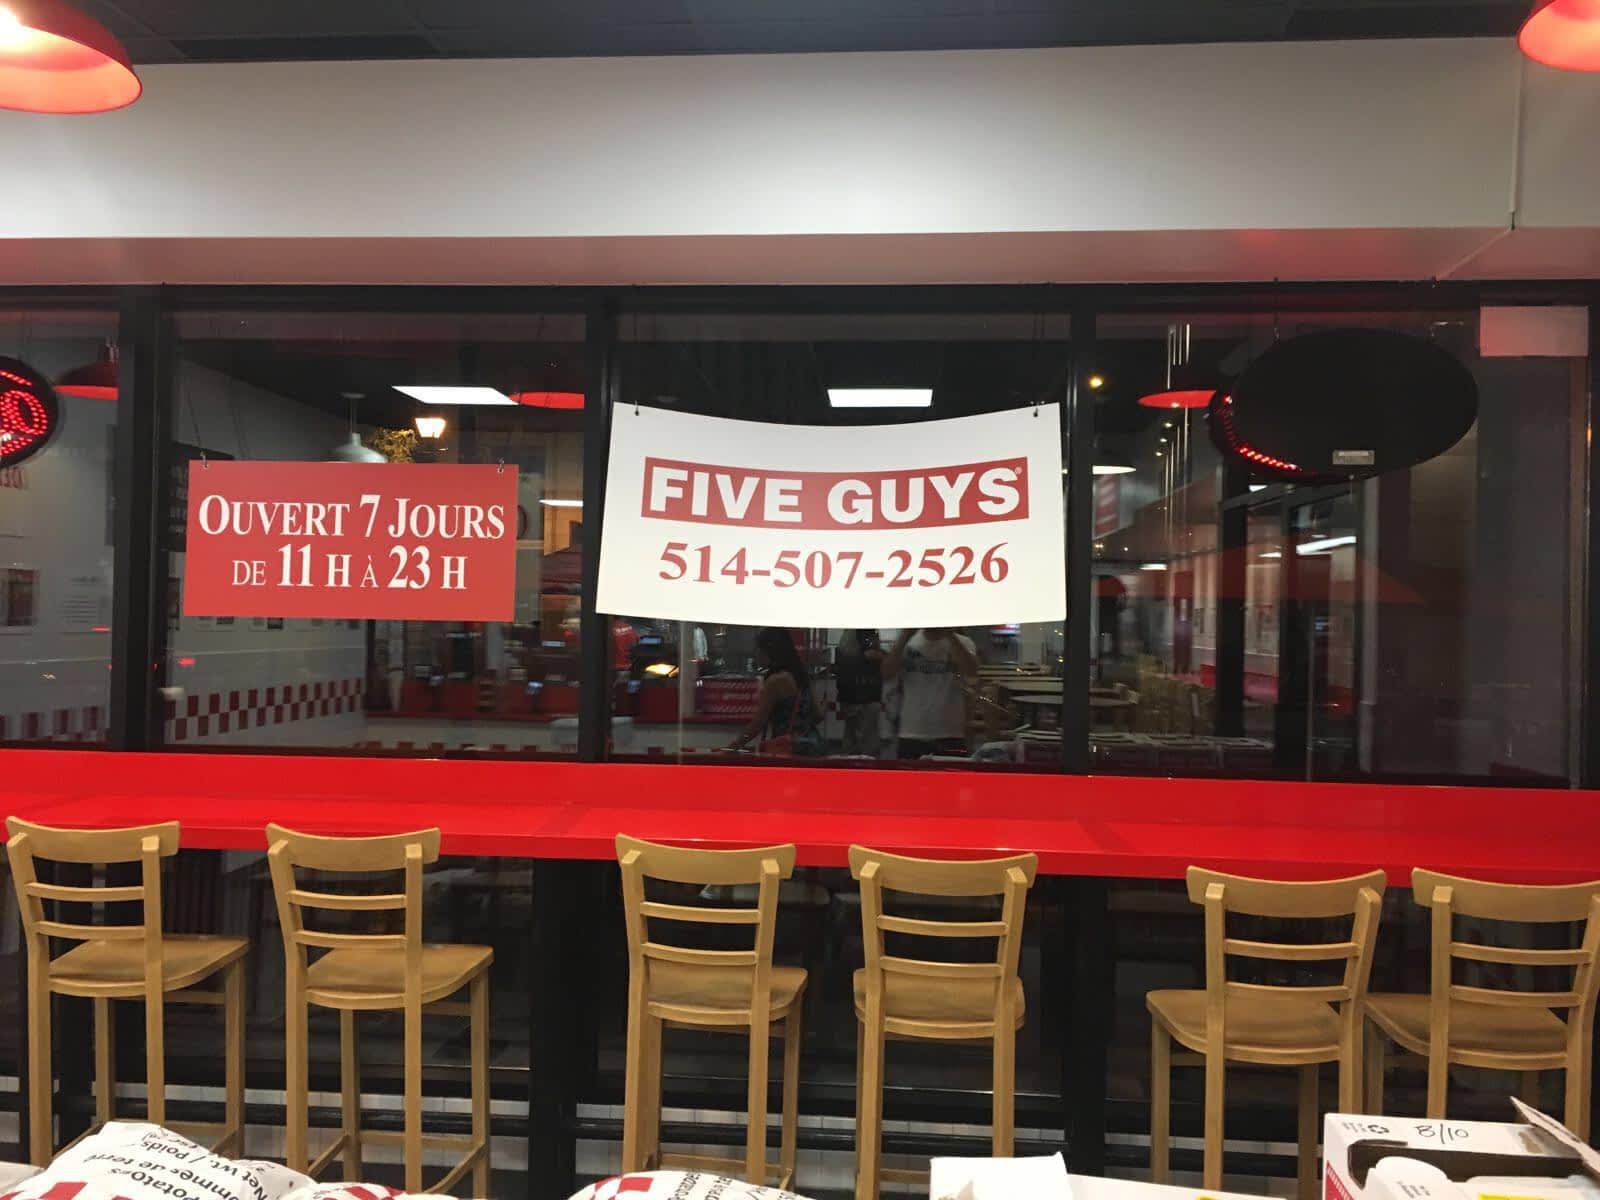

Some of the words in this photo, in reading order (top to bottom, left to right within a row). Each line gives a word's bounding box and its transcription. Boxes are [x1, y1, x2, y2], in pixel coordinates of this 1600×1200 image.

[199, 494, 350, 536] OUVERT
[359, 494, 381, 537] 7
[388, 498, 505, 539] JOURS
[649, 466, 803, 523] FIVE
[231, 560, 267, 586] DE
[276, 543, 314, 587] 11
[324, 554, 352, 588] H
[359, 555, 379, 588] À
[386, 545, 431, 590] 23
[439, 556, 468, 590] H
[659, 541, 1010, 590] 514-507-2526
[140, 1140, 189, 1160] Poids
